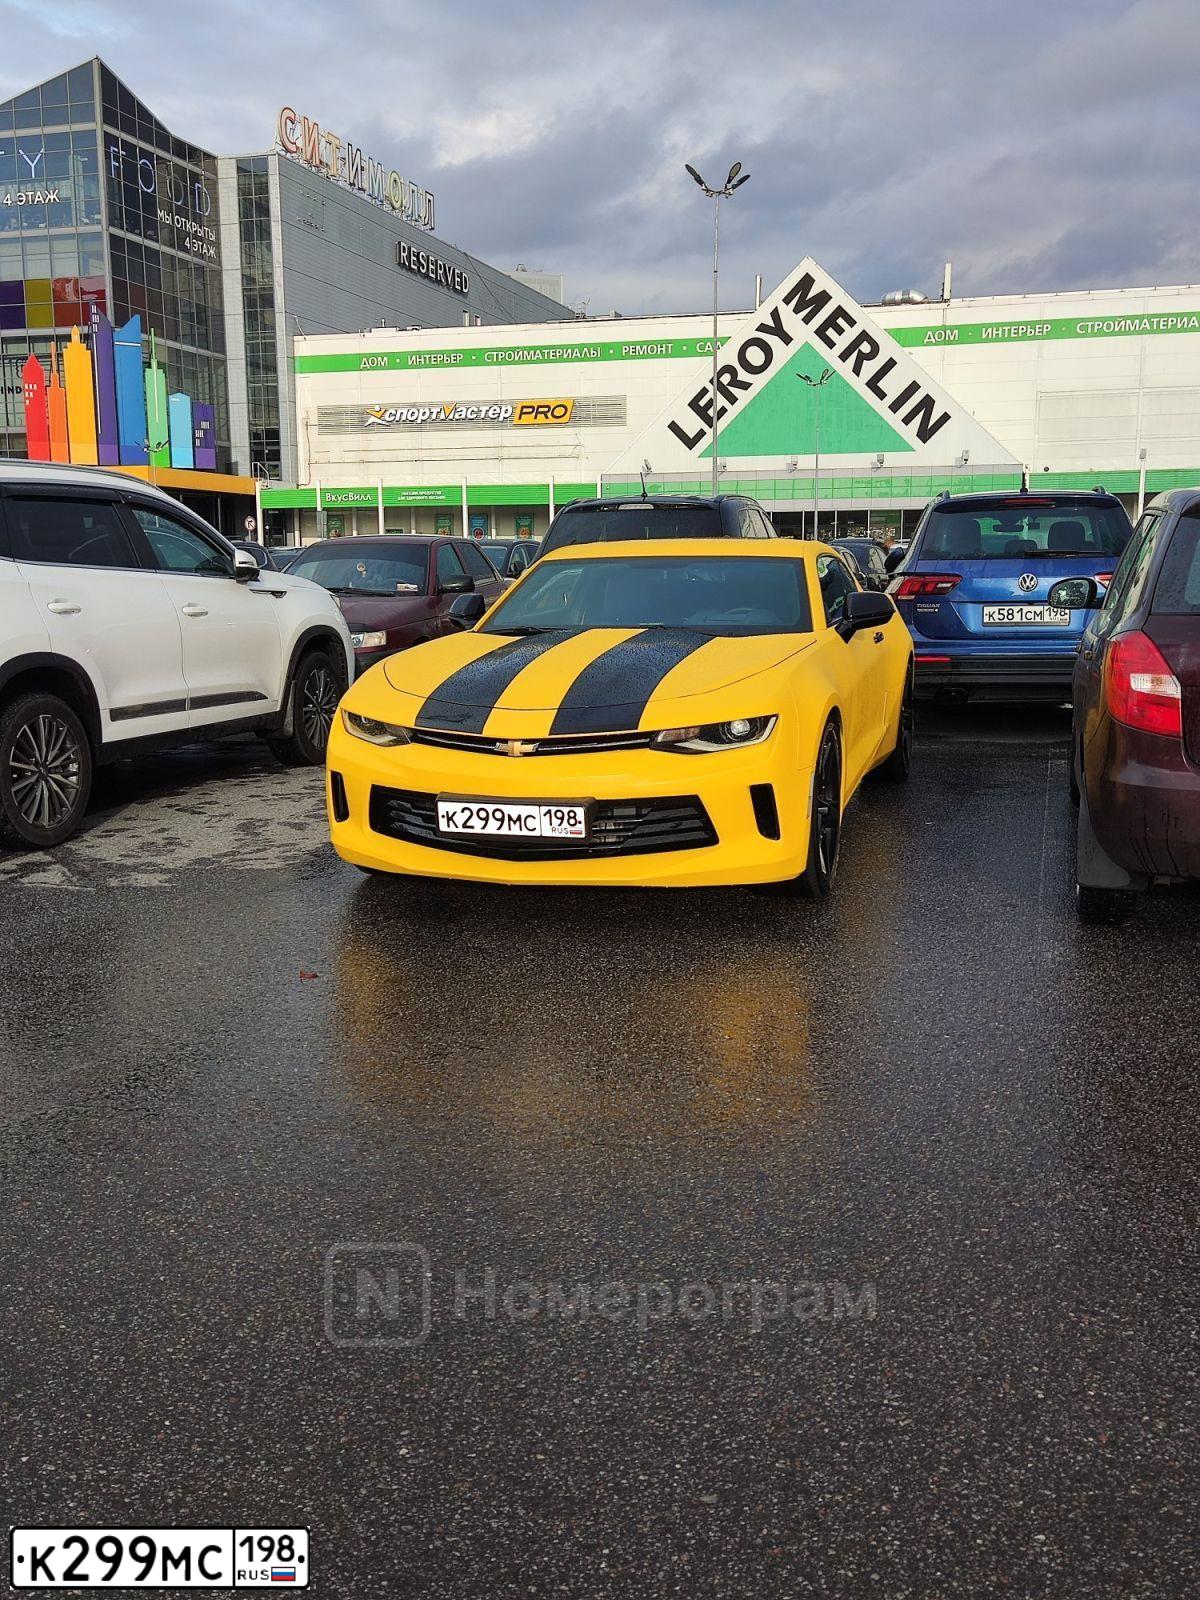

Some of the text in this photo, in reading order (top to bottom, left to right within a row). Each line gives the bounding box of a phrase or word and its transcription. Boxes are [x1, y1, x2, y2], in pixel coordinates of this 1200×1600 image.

[109, 145, 211, 217] FOOD
[3, 189, 60, 207] 4 ЭТАЖ
[157, 207, 216, 242] МЫ ОТКРЫТЫ
[184, 236, 217, 259] 4 ЭТАЖ
[398, 241, 470, 294] RESERVED
[924, 316, 1199, 343] ДОМ ИНТЕРЬЕР СТРОЙМАТЕРИА
[360, 356, 388, 369] ДОМ
[407, 353, 464, 366] ИНТЕРЬЕР
[484, 346, 601, 362] СТРОЙМАТЕРИАЛЫ
[622, 343, 674, 356] РЕМОНТ
[667, 272, 952, 451] LEROY MERLIN
[518, 403, 569, 421] PRO
[325, 492, 372, 503] ВкусВилл
[988, 607, 1066, 621] К581СМ 198
[445, 806, 577, 832] К299МС 198
[551, 826, 569, 835] RUS
